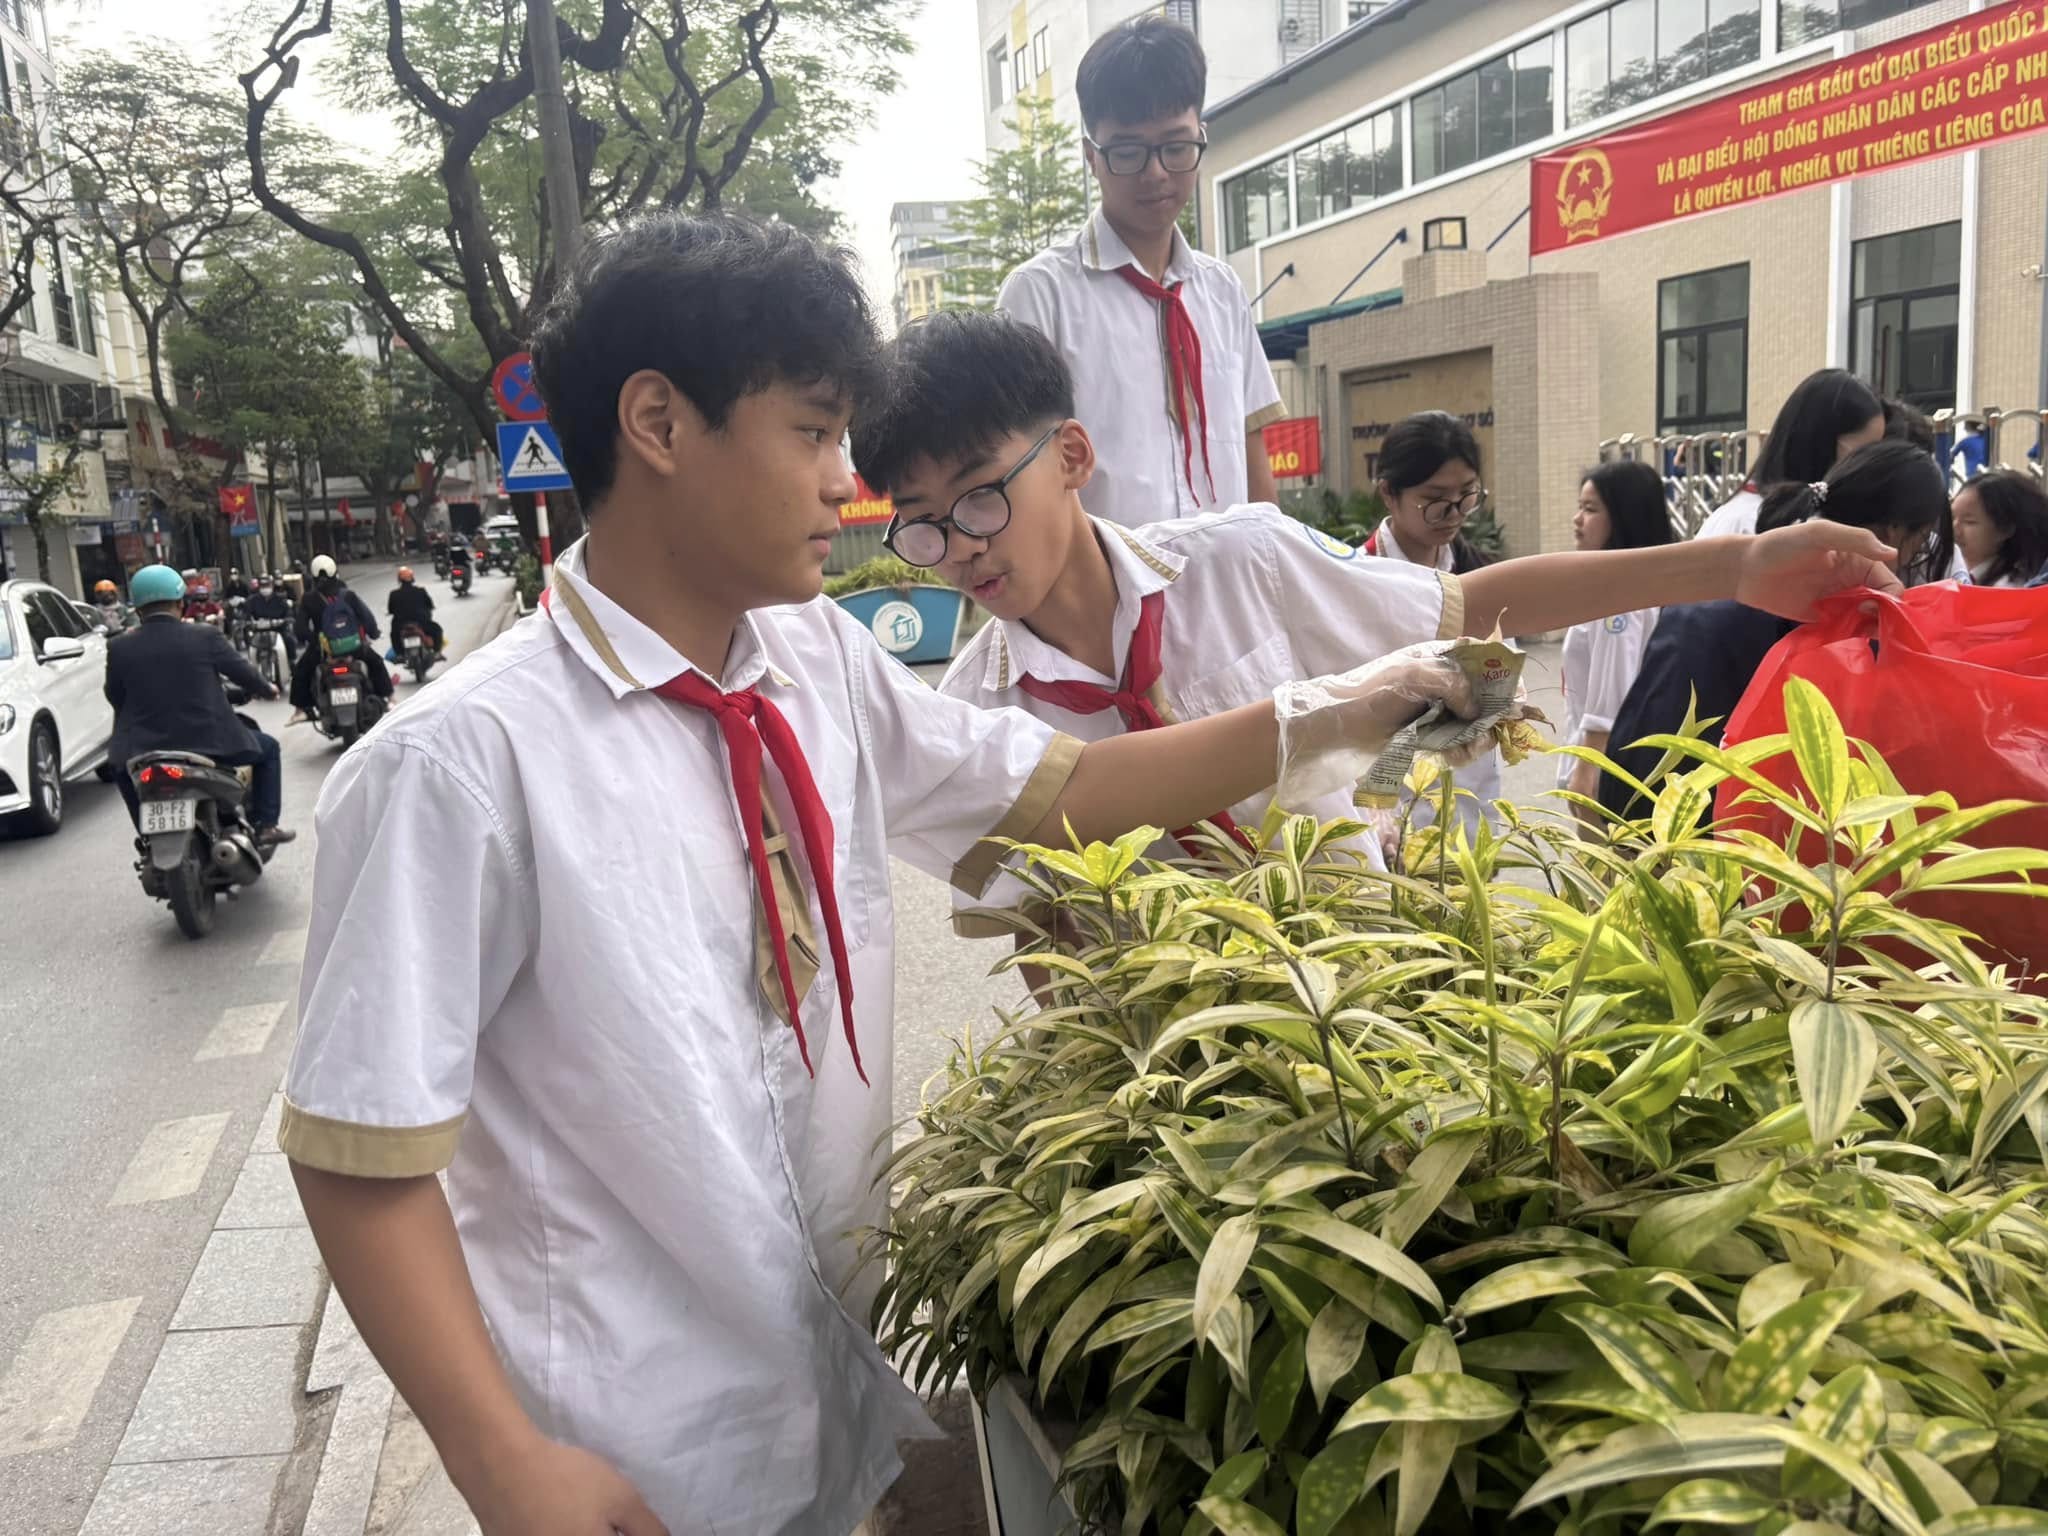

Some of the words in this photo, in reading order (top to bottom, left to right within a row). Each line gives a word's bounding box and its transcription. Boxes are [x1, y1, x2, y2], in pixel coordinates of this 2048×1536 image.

[1656, 157, 1674, 185] VÀ
[1677, 152, 1702, 181] ĐẠI
[1705, 136, 1740, 173] BIỂU
[1743, 131, 1769, 163] HỘI
[1773, 118, 1818, 153] ĐỒNG
[1822, 103, 1871, 139] NHÂN
[1877, 90, 1916, 125] DÂN
[1921, 76, 1961, 112] CÁC
[1967, 56, 2009, 99] CẤP
[1739, 91, 1783, 126] THAM
[1787, 82, 1815, 111] GIA
[1819, 65, 1853, 102] BẦU
[1858, 52, 1886, 89] CỬ
[1888, 47, 1921, 81] ĐẠI
[1926, 25, 1972, 69] BIỂU
[1977, 5, 2036, 54] QUỐC
[1673, 187, 1692, 216] LÀ
[1695, 173, 1744, 210] QUYỀN
[1780, 152, 1832, 190] NGHĨA
[1836, 147, 1859, 176] VỤ
[1863, 131, 1930, 168] THIÊNG
[1935, 111, 1994, 150] LIÊNG
[2000, 93, 2046, 132] CỦA
[840, 498, 892, 519] KHÔNG
[1482, 668, 1511, 683] Karo
